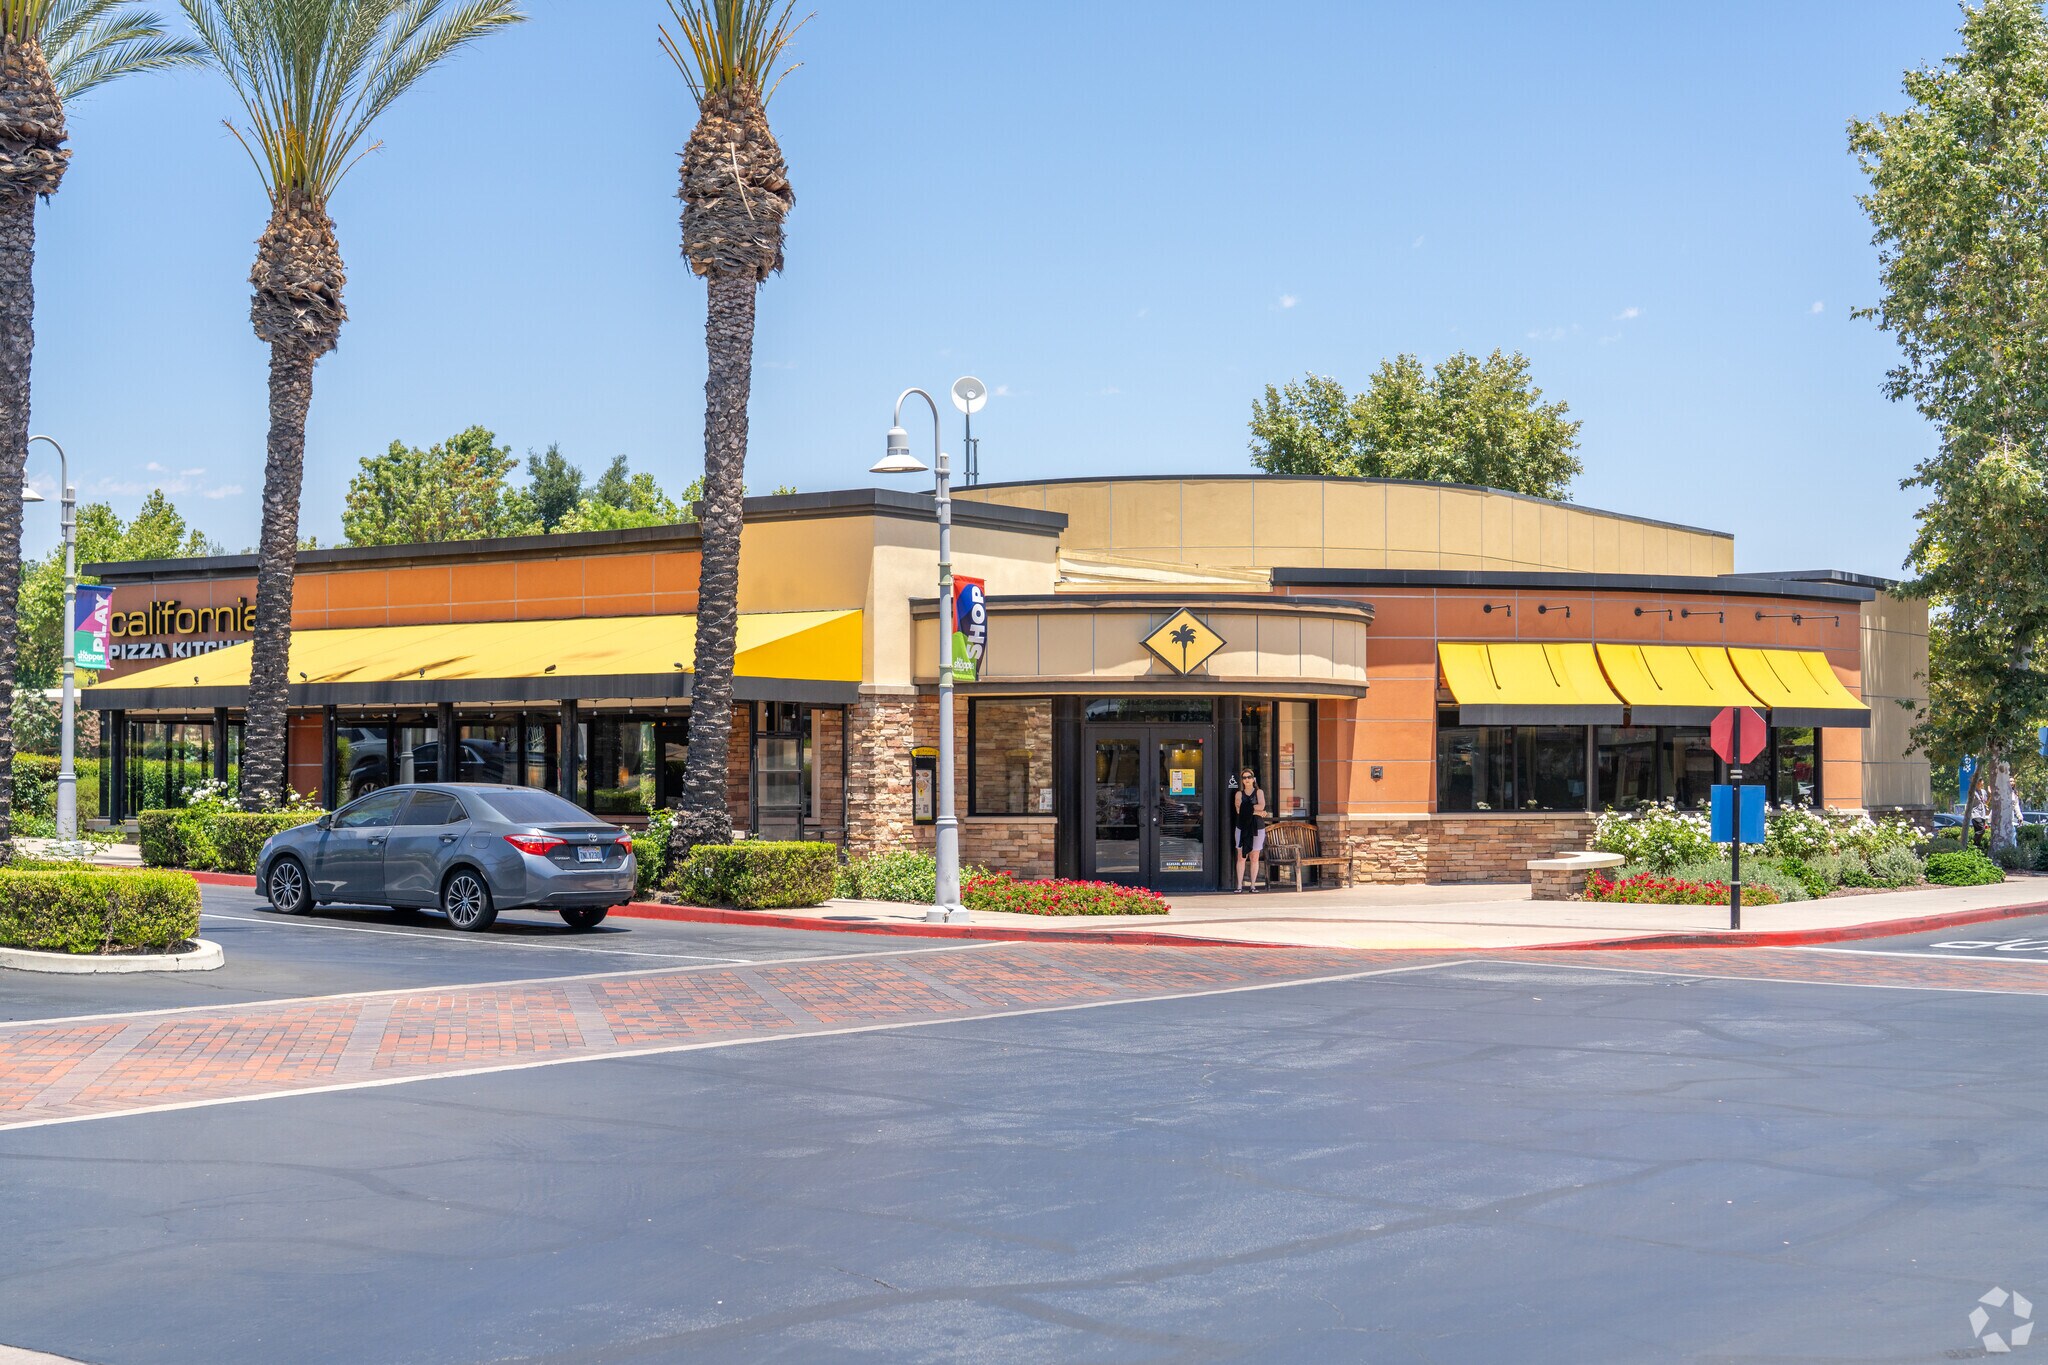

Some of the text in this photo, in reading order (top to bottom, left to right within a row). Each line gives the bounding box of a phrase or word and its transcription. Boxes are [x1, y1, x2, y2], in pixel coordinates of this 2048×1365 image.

[93, 593, 109, 652] PLAY
[109, 597, 256, 637] california
[966, 585, 986, 660] SHOP
[108, 643, 166, 660] PIZZA
